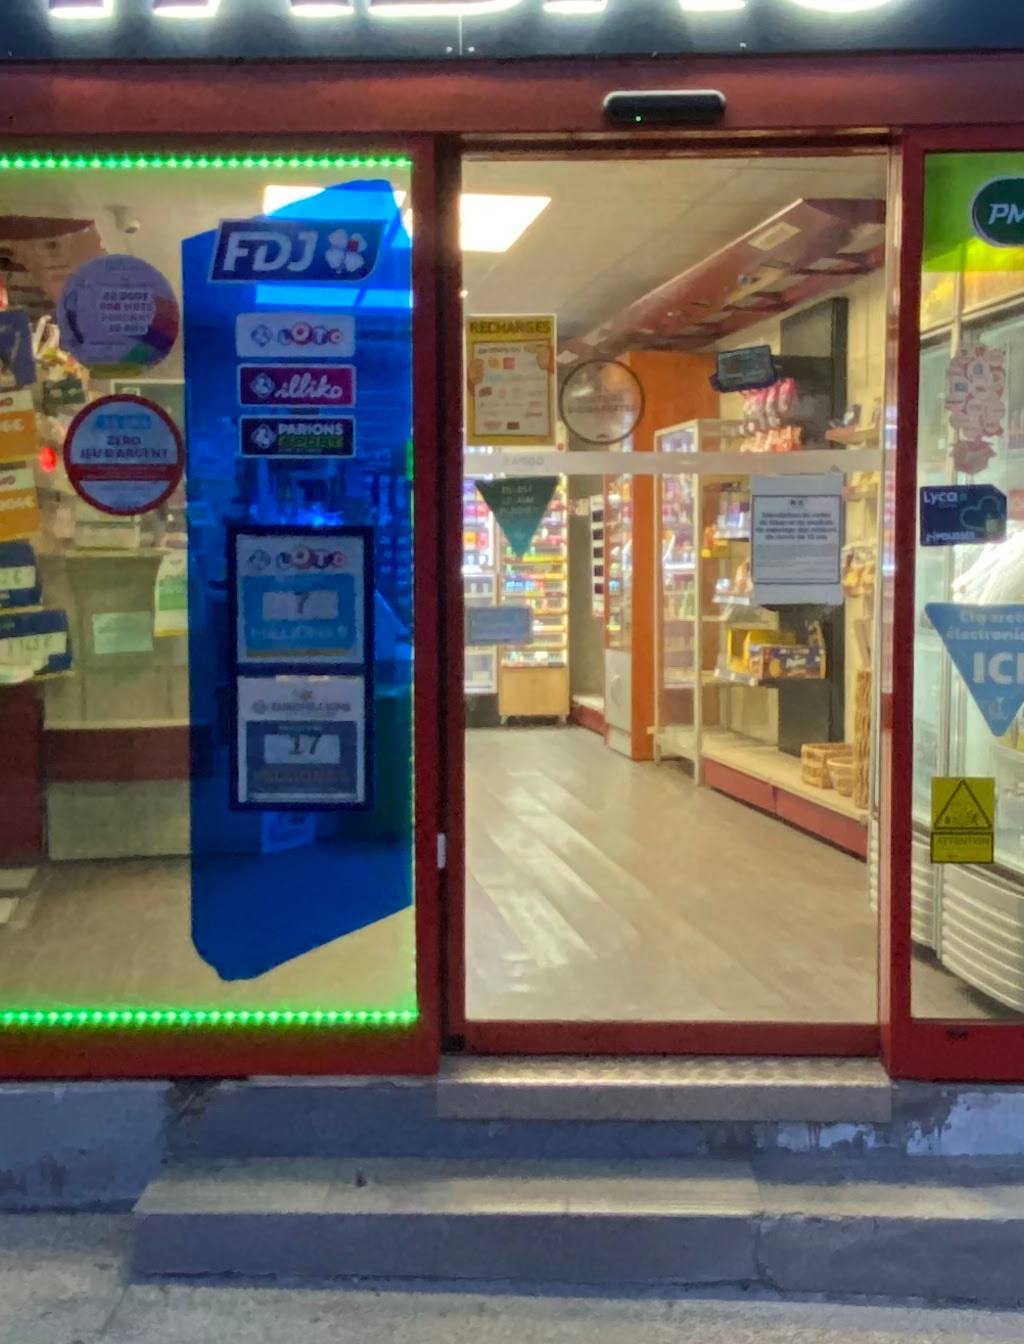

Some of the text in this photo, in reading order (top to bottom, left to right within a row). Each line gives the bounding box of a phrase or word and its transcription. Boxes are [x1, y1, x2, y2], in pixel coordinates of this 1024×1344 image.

[222, 231, 319, 272] FDJ
[277, 321, 344, 348] LOTO
[469, 319, 552, 334] RECHARGES
[274, 372, 344, 399] illiko
[278, 423, 344, 436] PARIONS
[923, 490, 958, 505] Lyca
